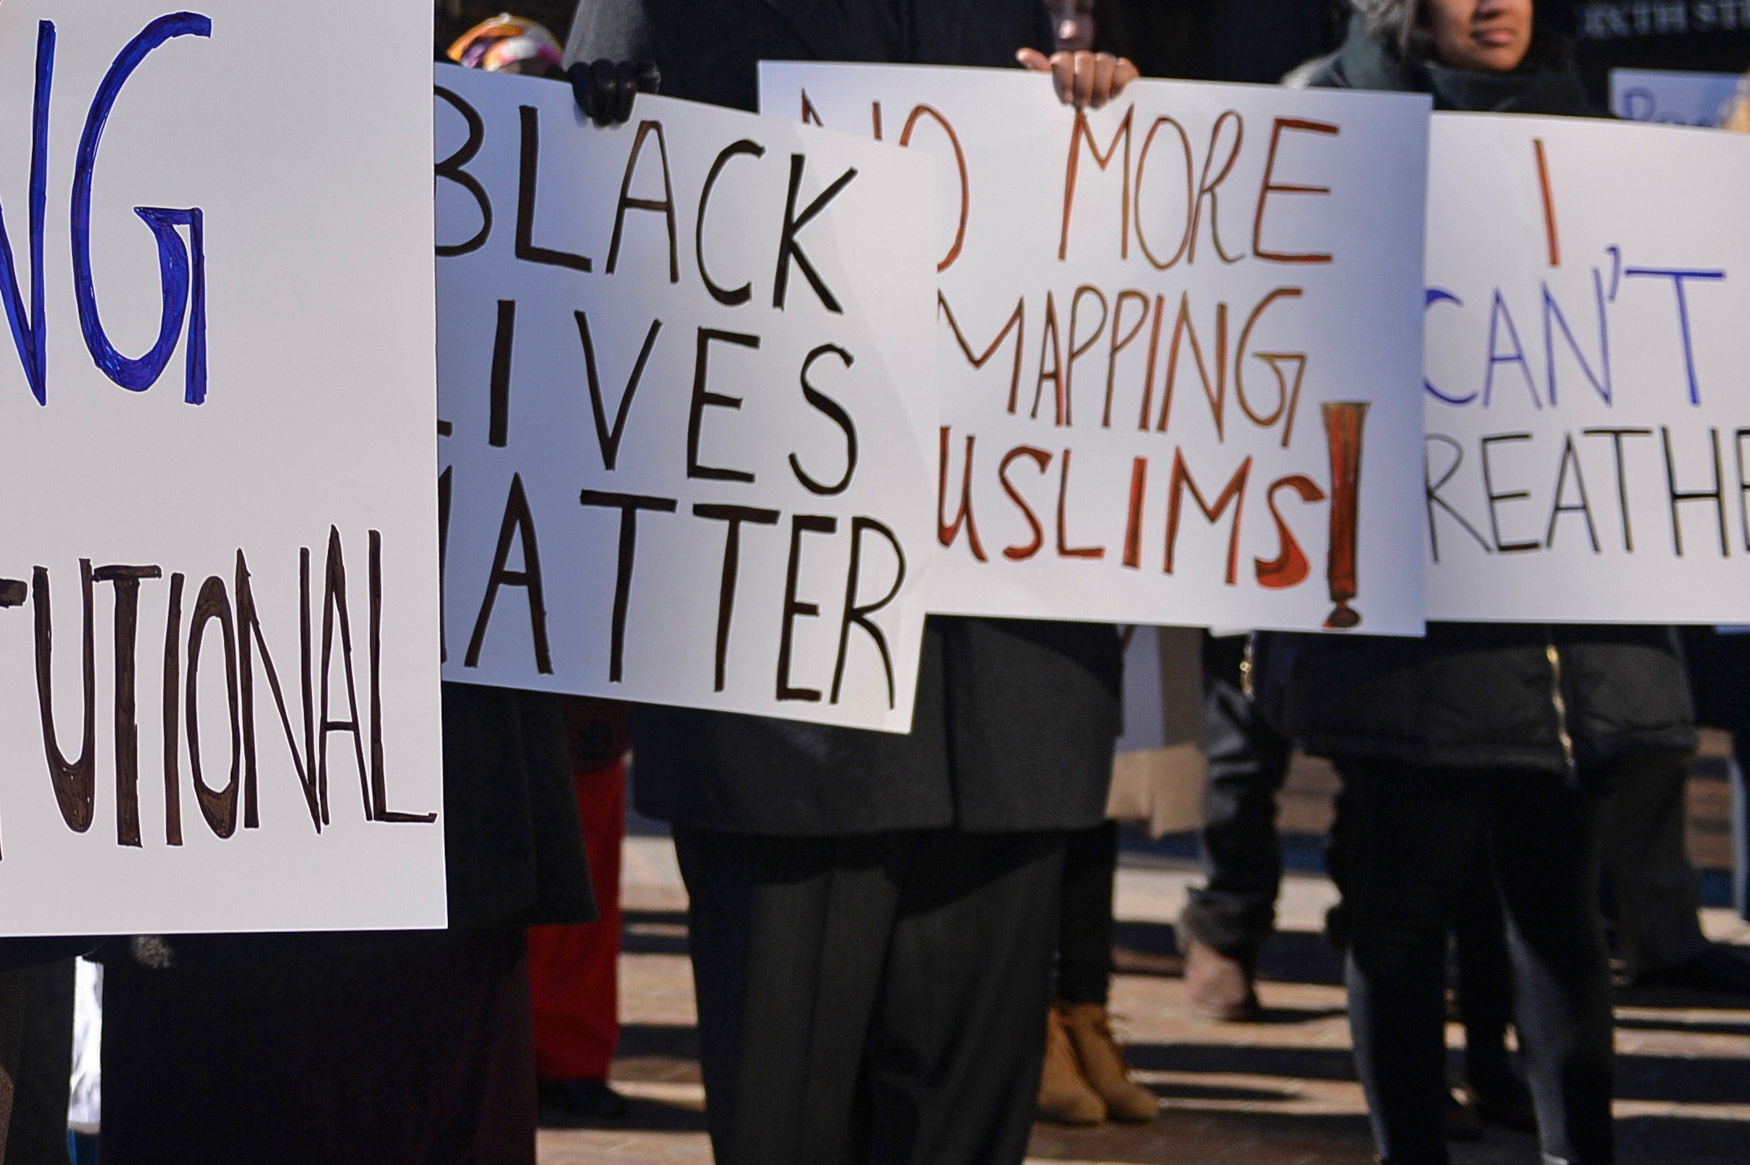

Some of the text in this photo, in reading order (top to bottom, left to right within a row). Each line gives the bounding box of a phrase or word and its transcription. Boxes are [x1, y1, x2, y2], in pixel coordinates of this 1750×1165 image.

[434, 84, 858, 315] BLACK
[1058, 101, 1340, 271] MORE
[1532, 138, 1561, 267] I
[436, 299, 858, 496] IVES
[937, 285, 1307, 449] MAPPING
[1424, 244, 1726, 410] CAN'T
[937, 400, 1371, 629] USLIMS!
[1424, 425, 1750, 559] REATH
[438, 464, 907, 711] ATTER
